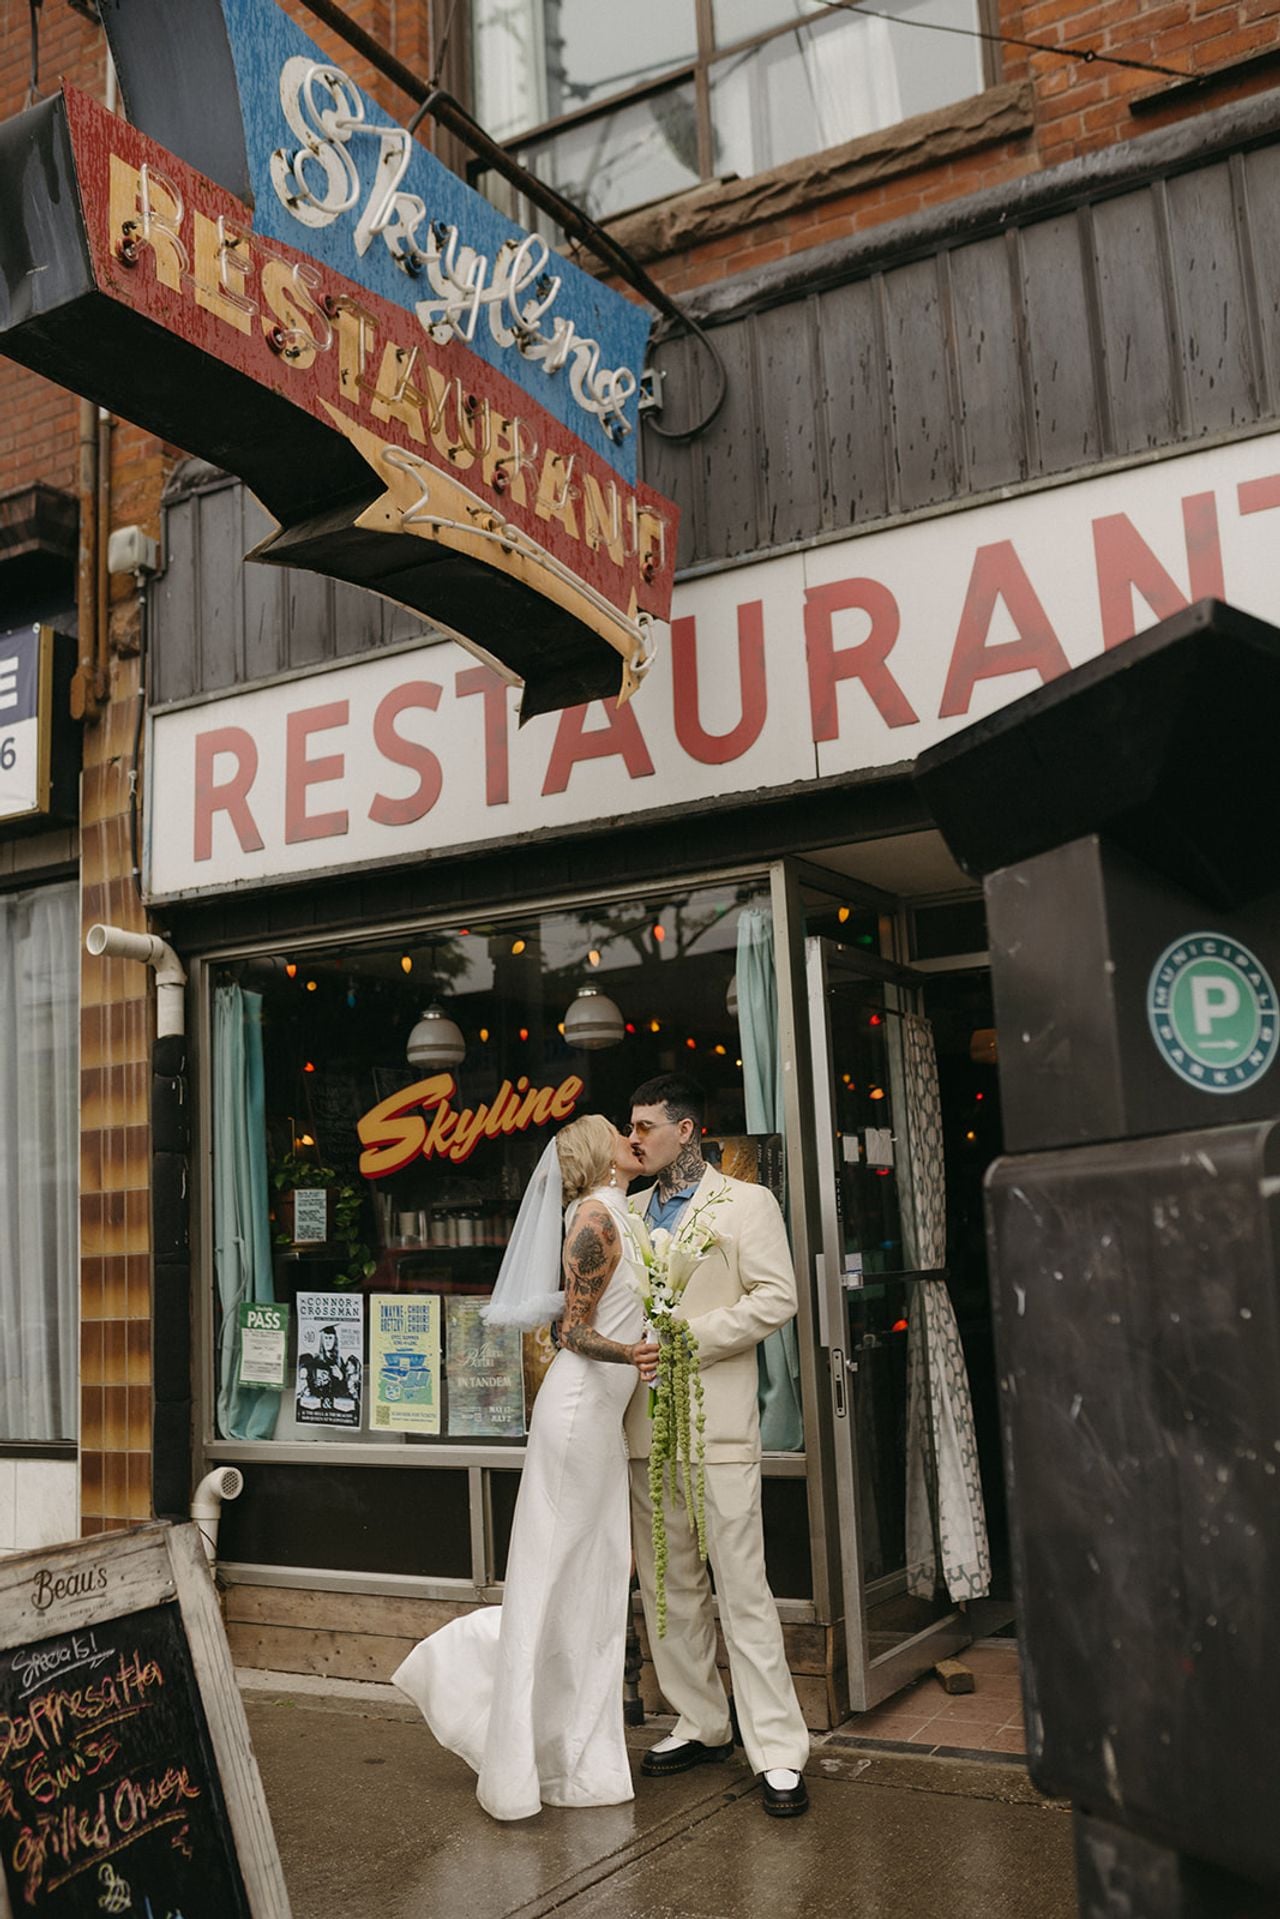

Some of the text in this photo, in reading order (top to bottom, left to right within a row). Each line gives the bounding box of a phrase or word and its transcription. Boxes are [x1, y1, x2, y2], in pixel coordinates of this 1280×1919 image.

[269, 55, 637, 446] Skyline
[109, 152, 670, 582] RESTAURANT
[193, 474, 1280, 862] RESTAURAN
[1155, 940, 1269, 1006] MUNICIPAL
[1191, 976, 1241, 1035] P
[1160, 1025, 1273, 1084] PARKING
[357, 1072, 584, 1180] Skyline
[247, 1311, 280, 1329] PASS
[300, 1306, 360, 1316] CROSSMAN
[307, 1297, 352, 1307] CONNOR
[469, 1376, 512, 1388] TANDEM
[31, 1565, 107, 1611] Beau's
